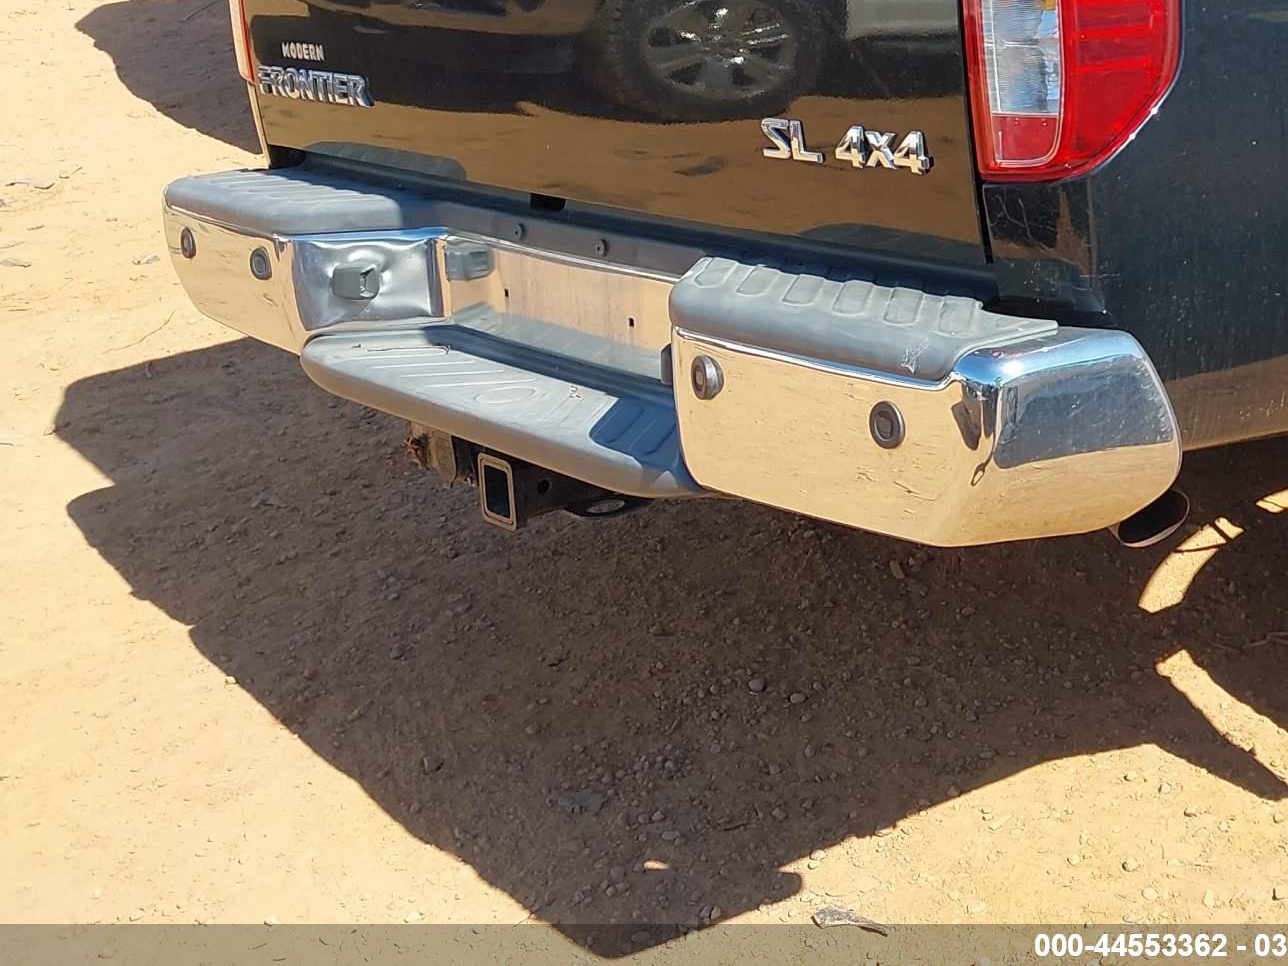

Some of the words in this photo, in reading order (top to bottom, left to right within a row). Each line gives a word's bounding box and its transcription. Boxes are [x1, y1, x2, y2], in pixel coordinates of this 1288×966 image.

[281, 41, 325, 62] MODERN
[258, 65, 374, 107] FRONTIER
[761, 117, 824, 164] SL
